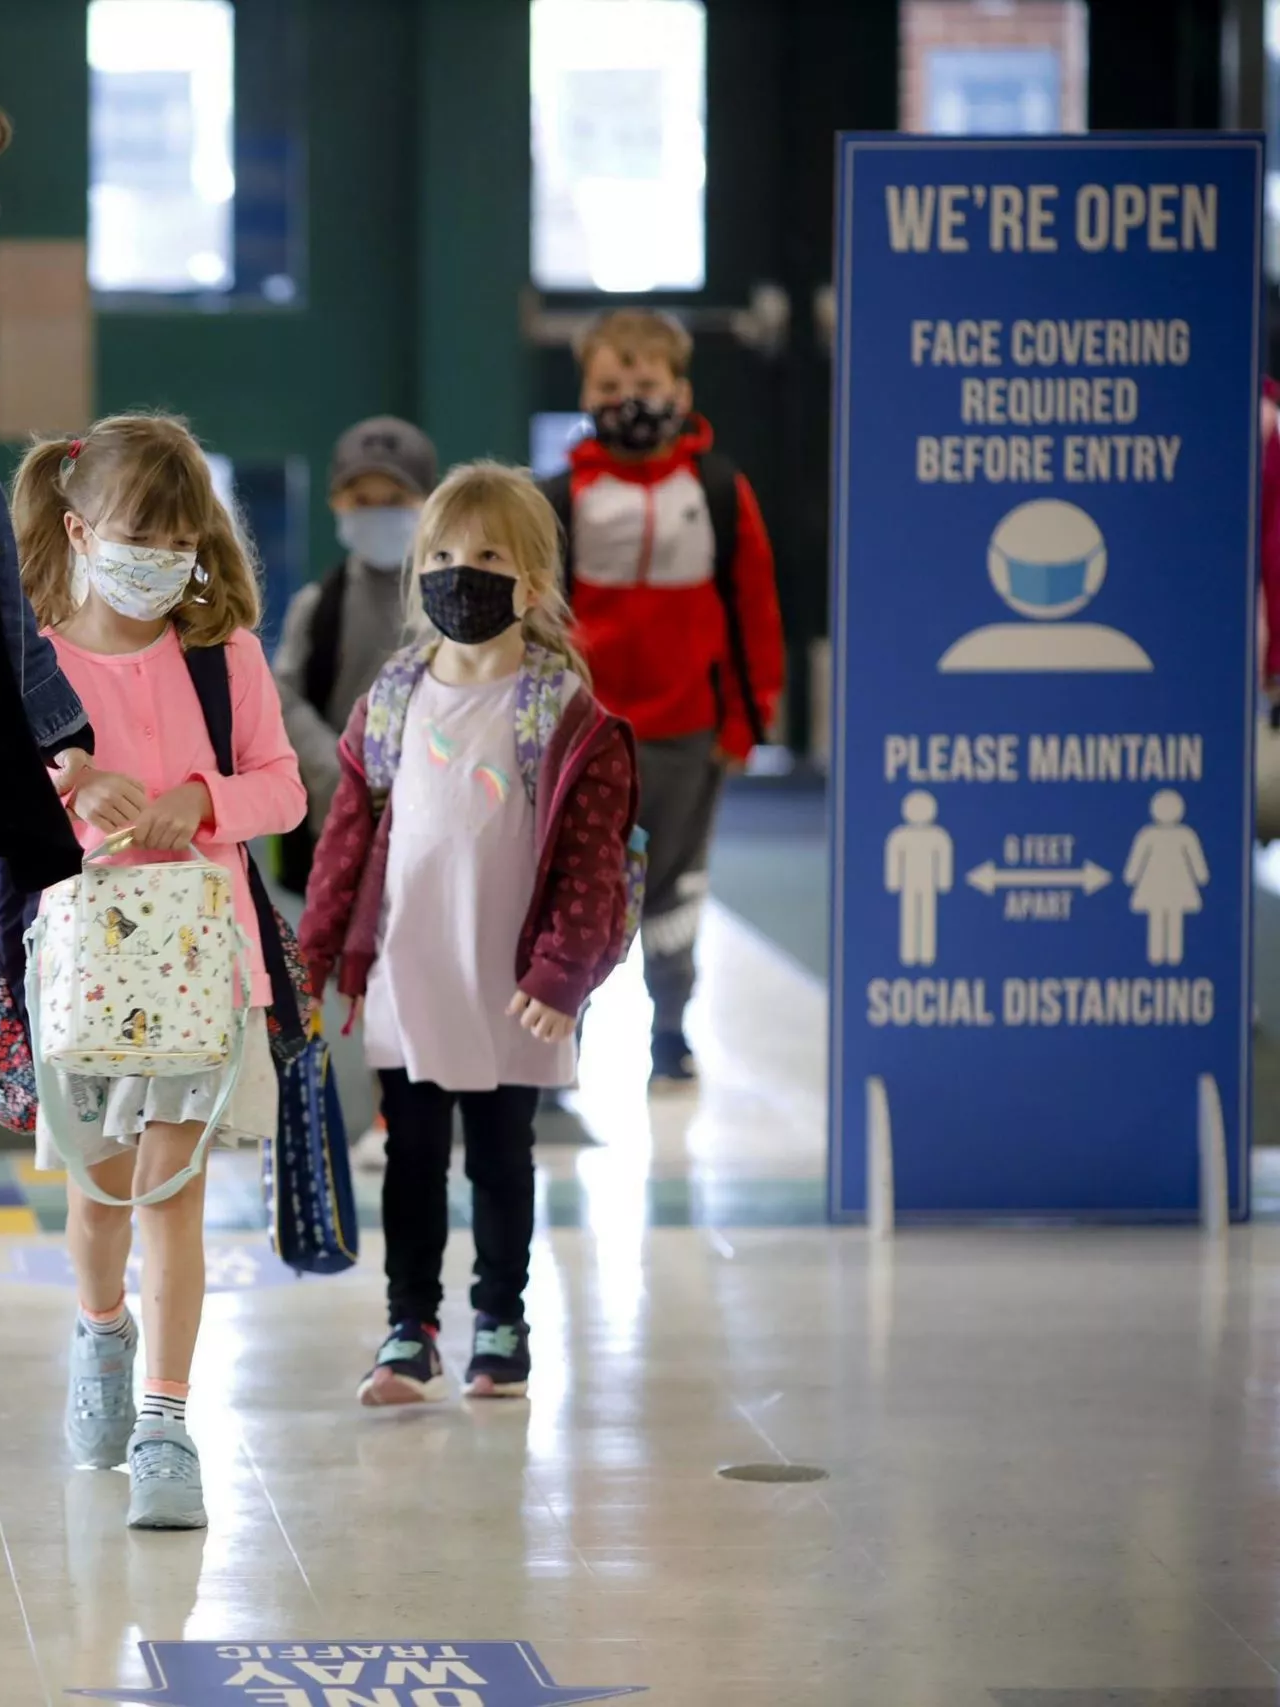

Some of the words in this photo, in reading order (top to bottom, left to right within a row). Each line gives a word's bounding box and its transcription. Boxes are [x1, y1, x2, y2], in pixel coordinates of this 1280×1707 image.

[885, 184, 1059, 253] WE'RE
[1075, 184, 1218, 253] OPEN
[910, 319, 1003, 367] FACE
[1011, 319, 1190, 367] COVERING
[960, 377, 1138, 426] REQUIRED
[916, 435, 1054, 483] BEFORE
[1063, 435, 1182, 482] ENTRY
[883, 734, 1019, 783] PLEASE
[1028, 734, 1203, 783] MAINTAIN
[1023, 833, 1075, 863] FEET
[1004, 890, 1073, 920] APART
[866, 977, 994, 1028] SOCIAL
[1002, 977, 1215, 1027] DISTANCING
[215, 1645, 469, 1660] TRAFFIC
[222, 1661, 489, 1685] WAY
